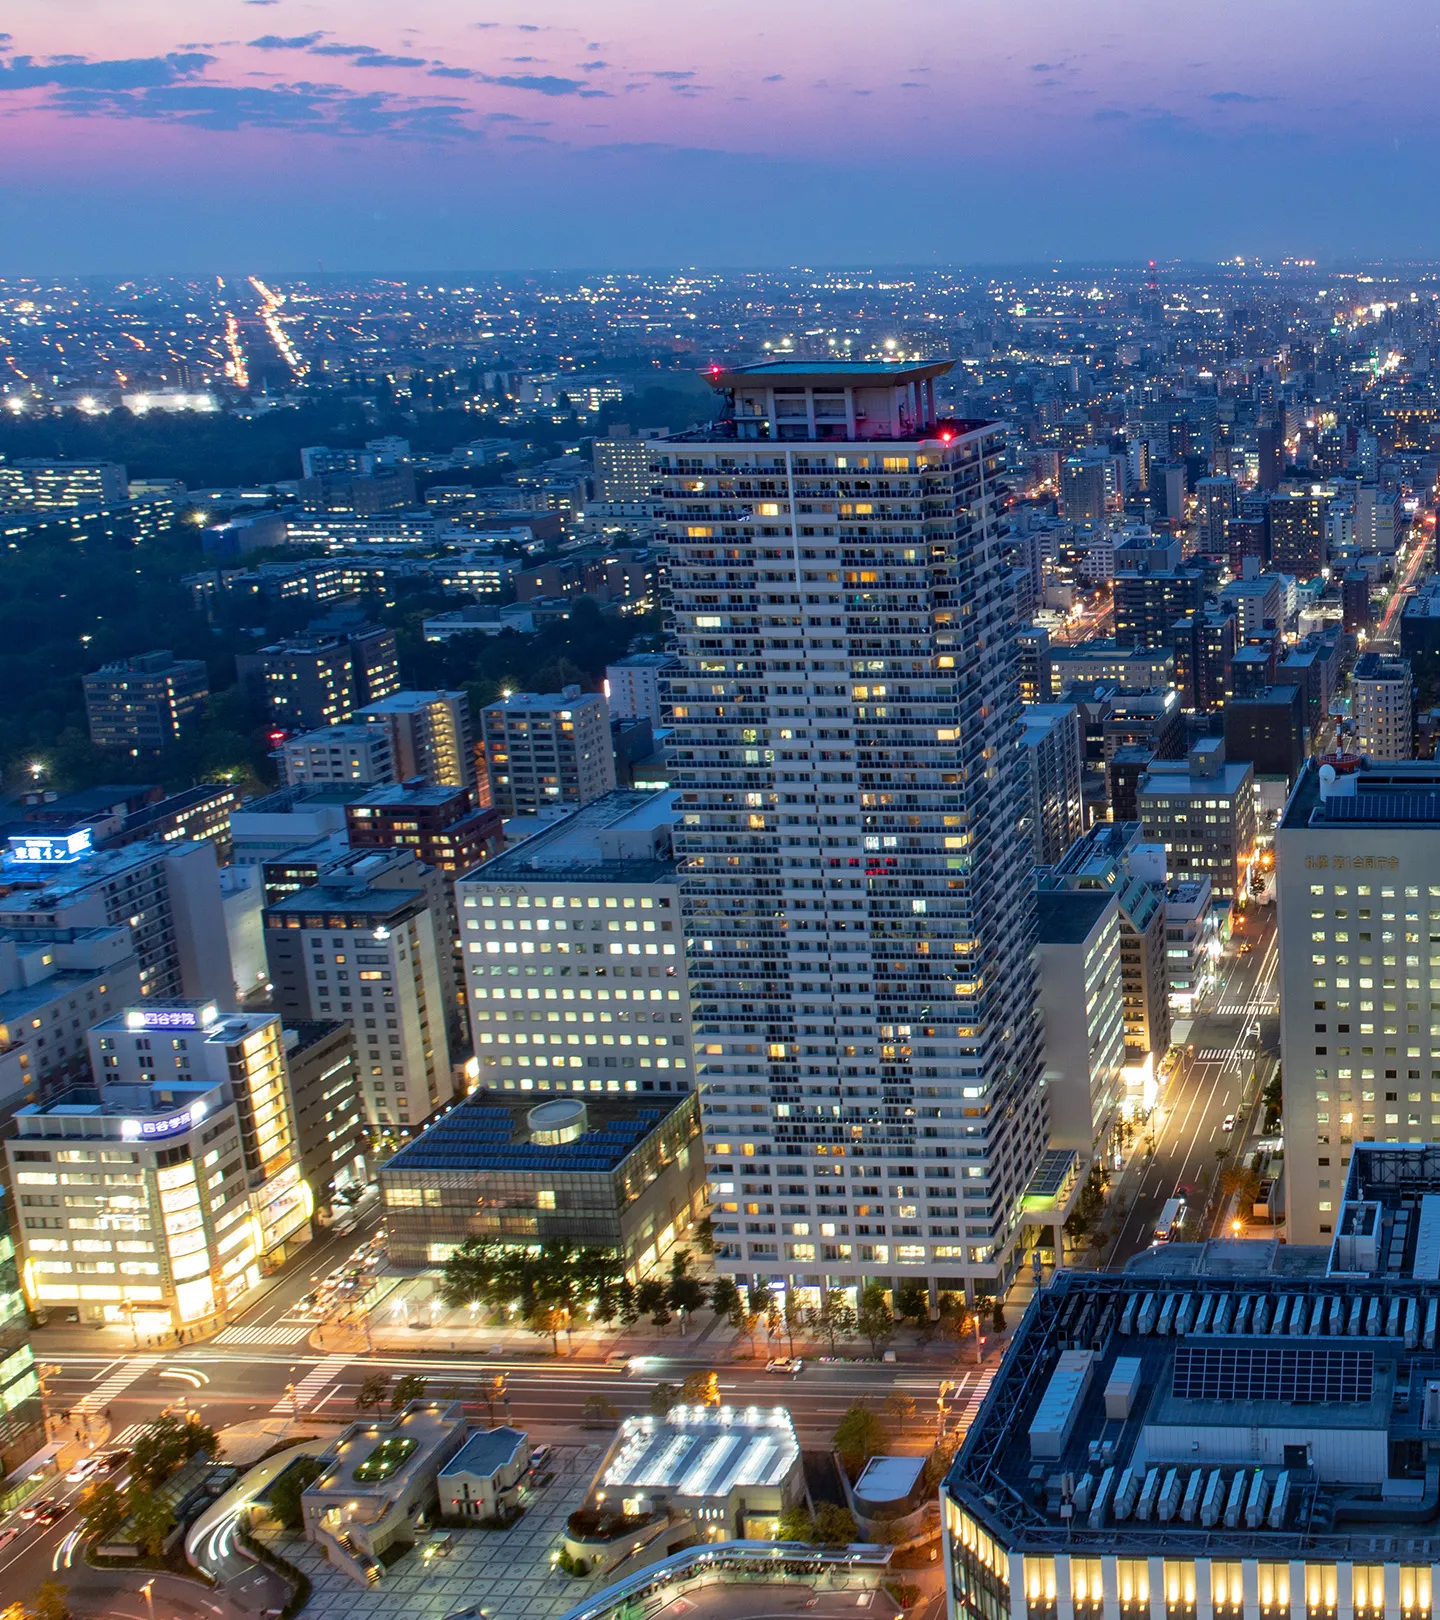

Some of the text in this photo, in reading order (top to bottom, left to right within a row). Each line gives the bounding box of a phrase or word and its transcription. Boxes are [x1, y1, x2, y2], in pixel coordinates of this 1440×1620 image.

[145, 1012, 197, 1026] 四谷学院
[142, 1112, 191, 1134] 四谷学院
